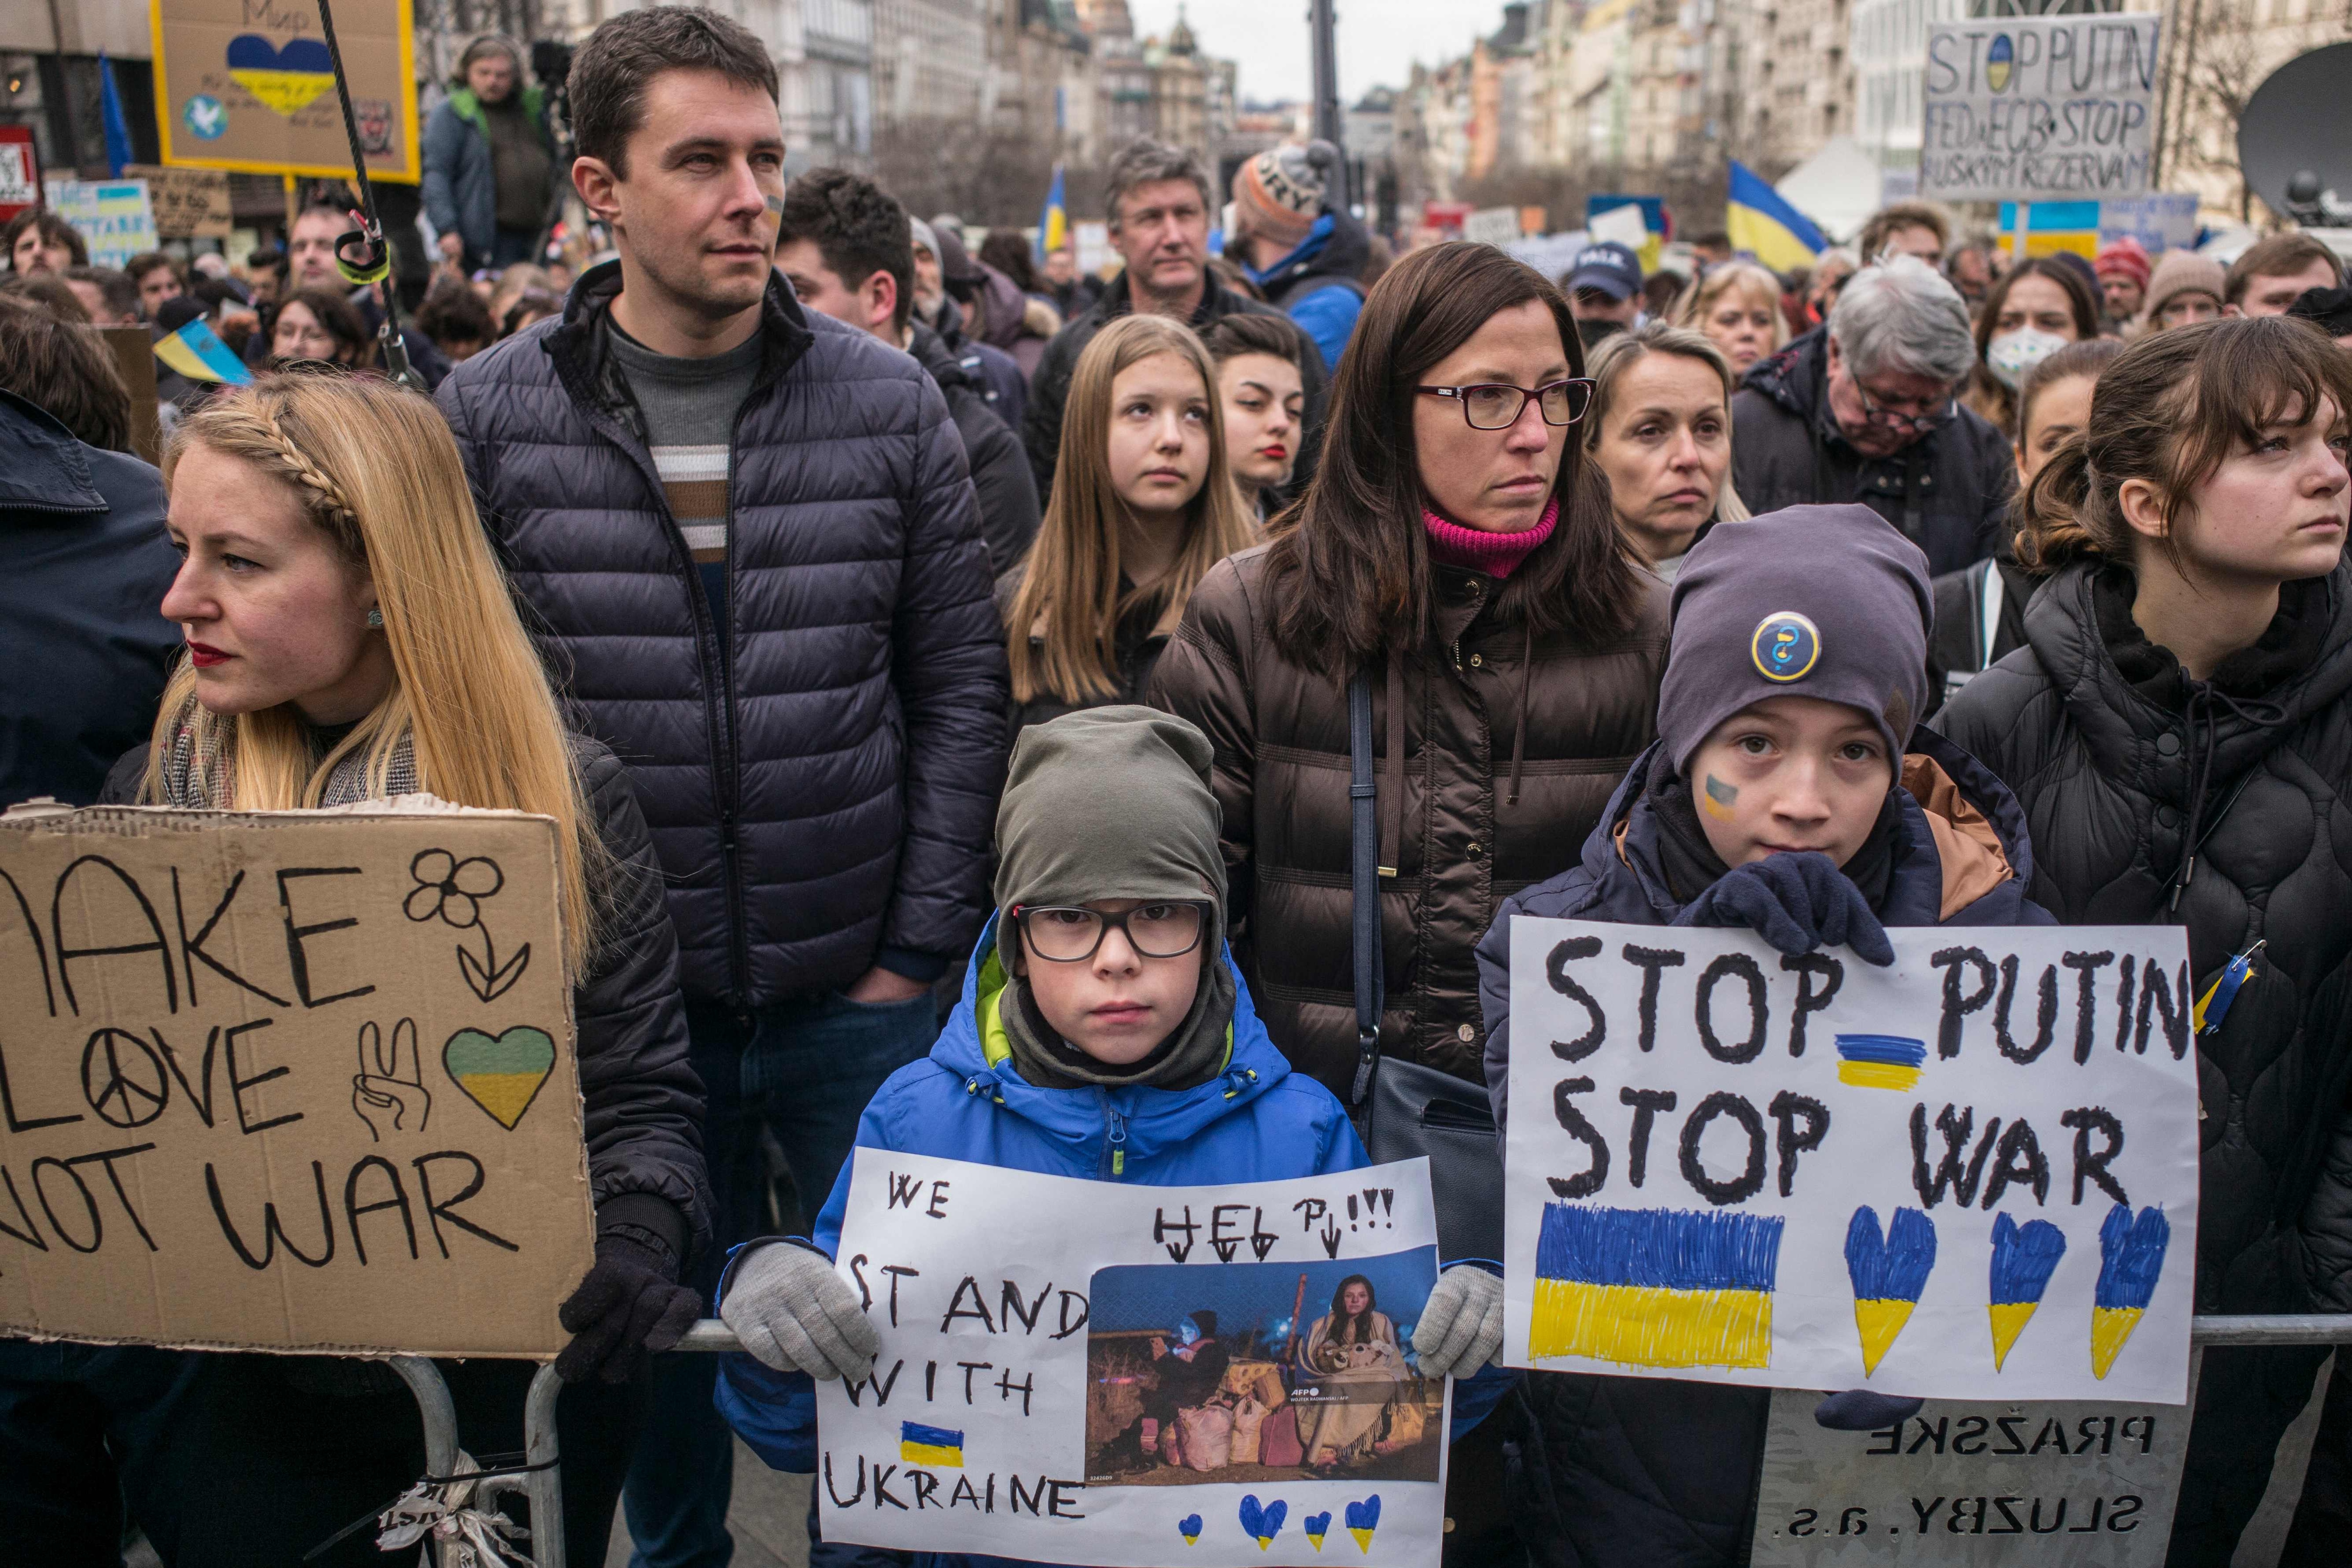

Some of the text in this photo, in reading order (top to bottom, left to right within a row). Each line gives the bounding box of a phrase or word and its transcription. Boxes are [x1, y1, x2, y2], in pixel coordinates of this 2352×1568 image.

[2044, 21, 2160, 94] PUTIN
[1546, 935, 2190, 1066] STOP PUTIN
[1546, 1075, 2130, 1211] STOP WAR
[205, 1150, 520, 1270] WAR
[888, 1170, 950, 1219] WE
[841, 1352, 1033, 1417] WITH
[824, 1451, 1086, 1519] UKRAINE
